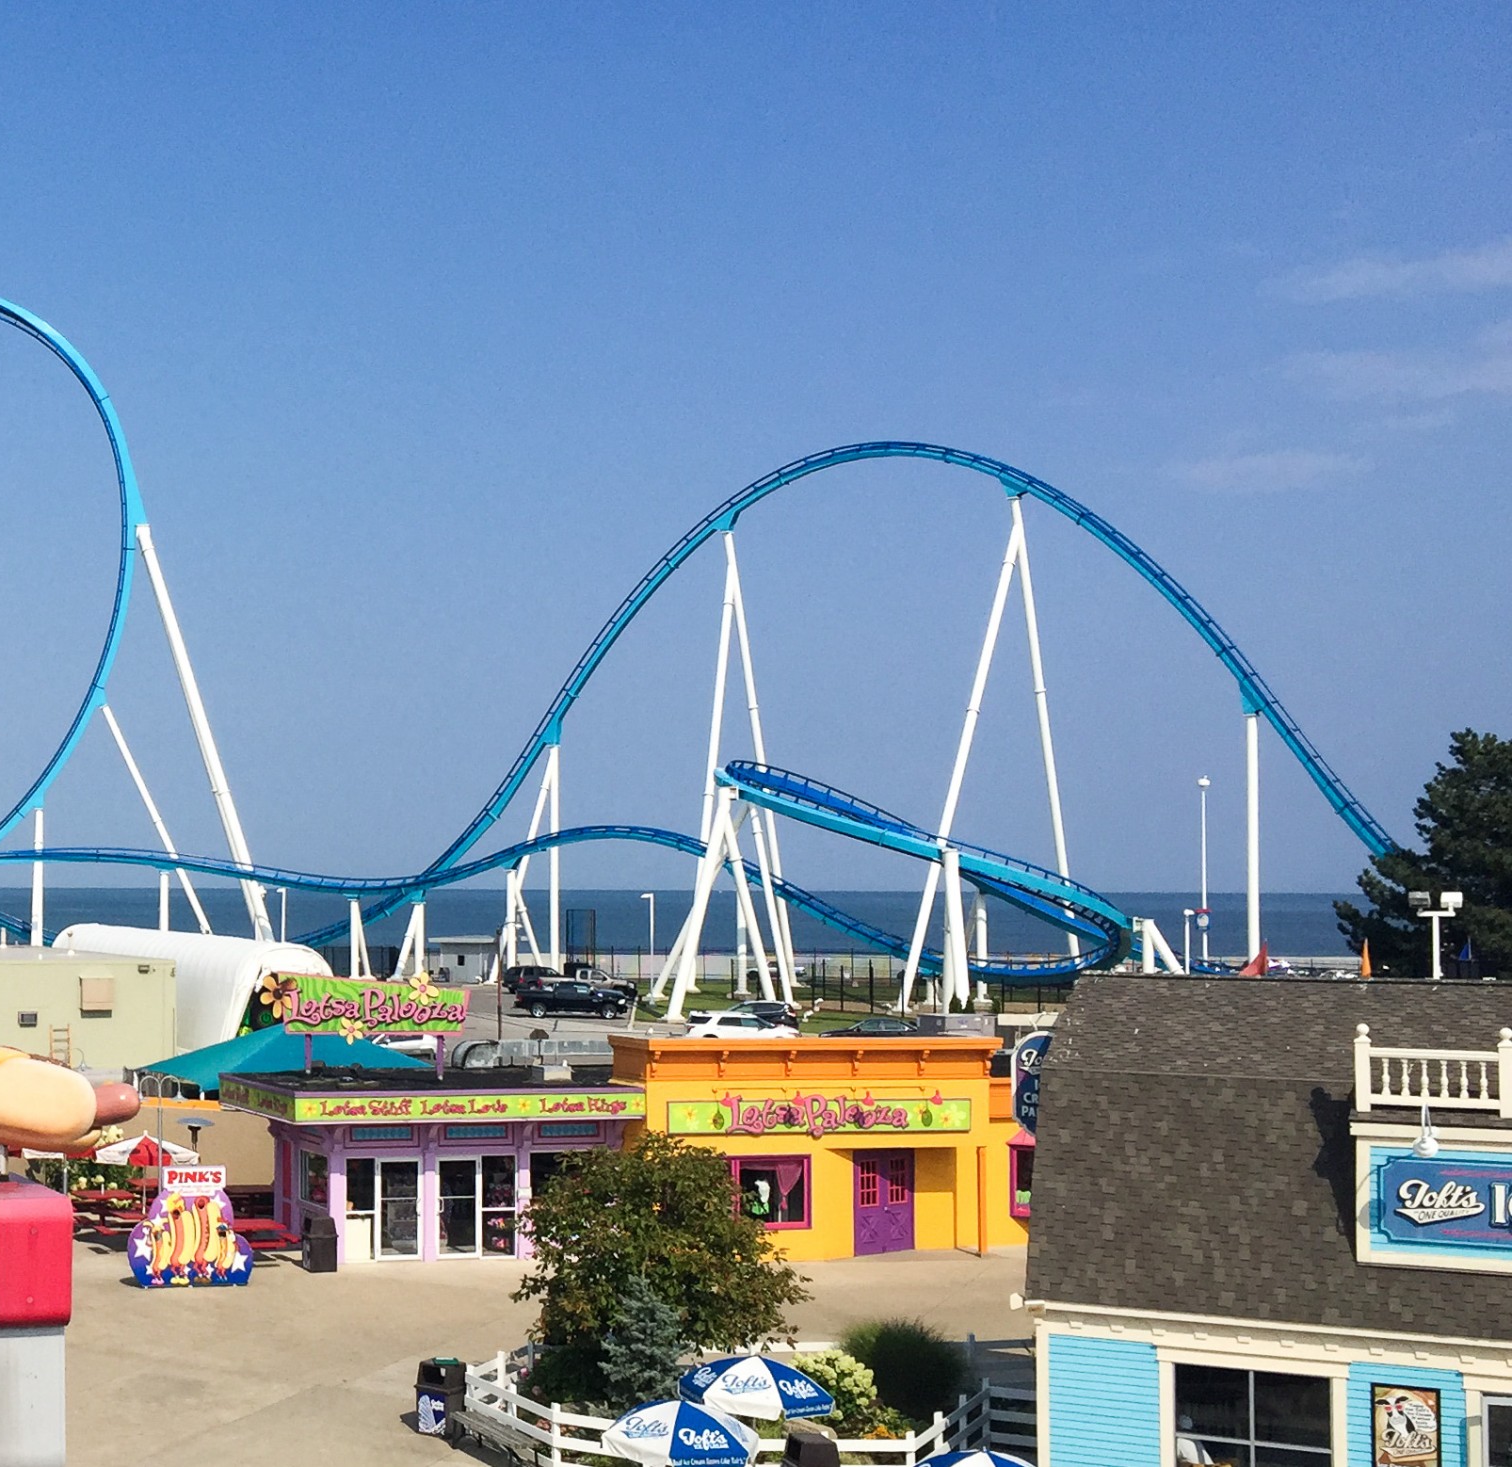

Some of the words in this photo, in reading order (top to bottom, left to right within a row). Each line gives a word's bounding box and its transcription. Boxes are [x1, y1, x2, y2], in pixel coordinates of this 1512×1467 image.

[167, 1170, 223, 1184] PINK'S
[1398, 1179, 1479, 1208] Toft's
[678, 1427, 728, 1450] Toft's
